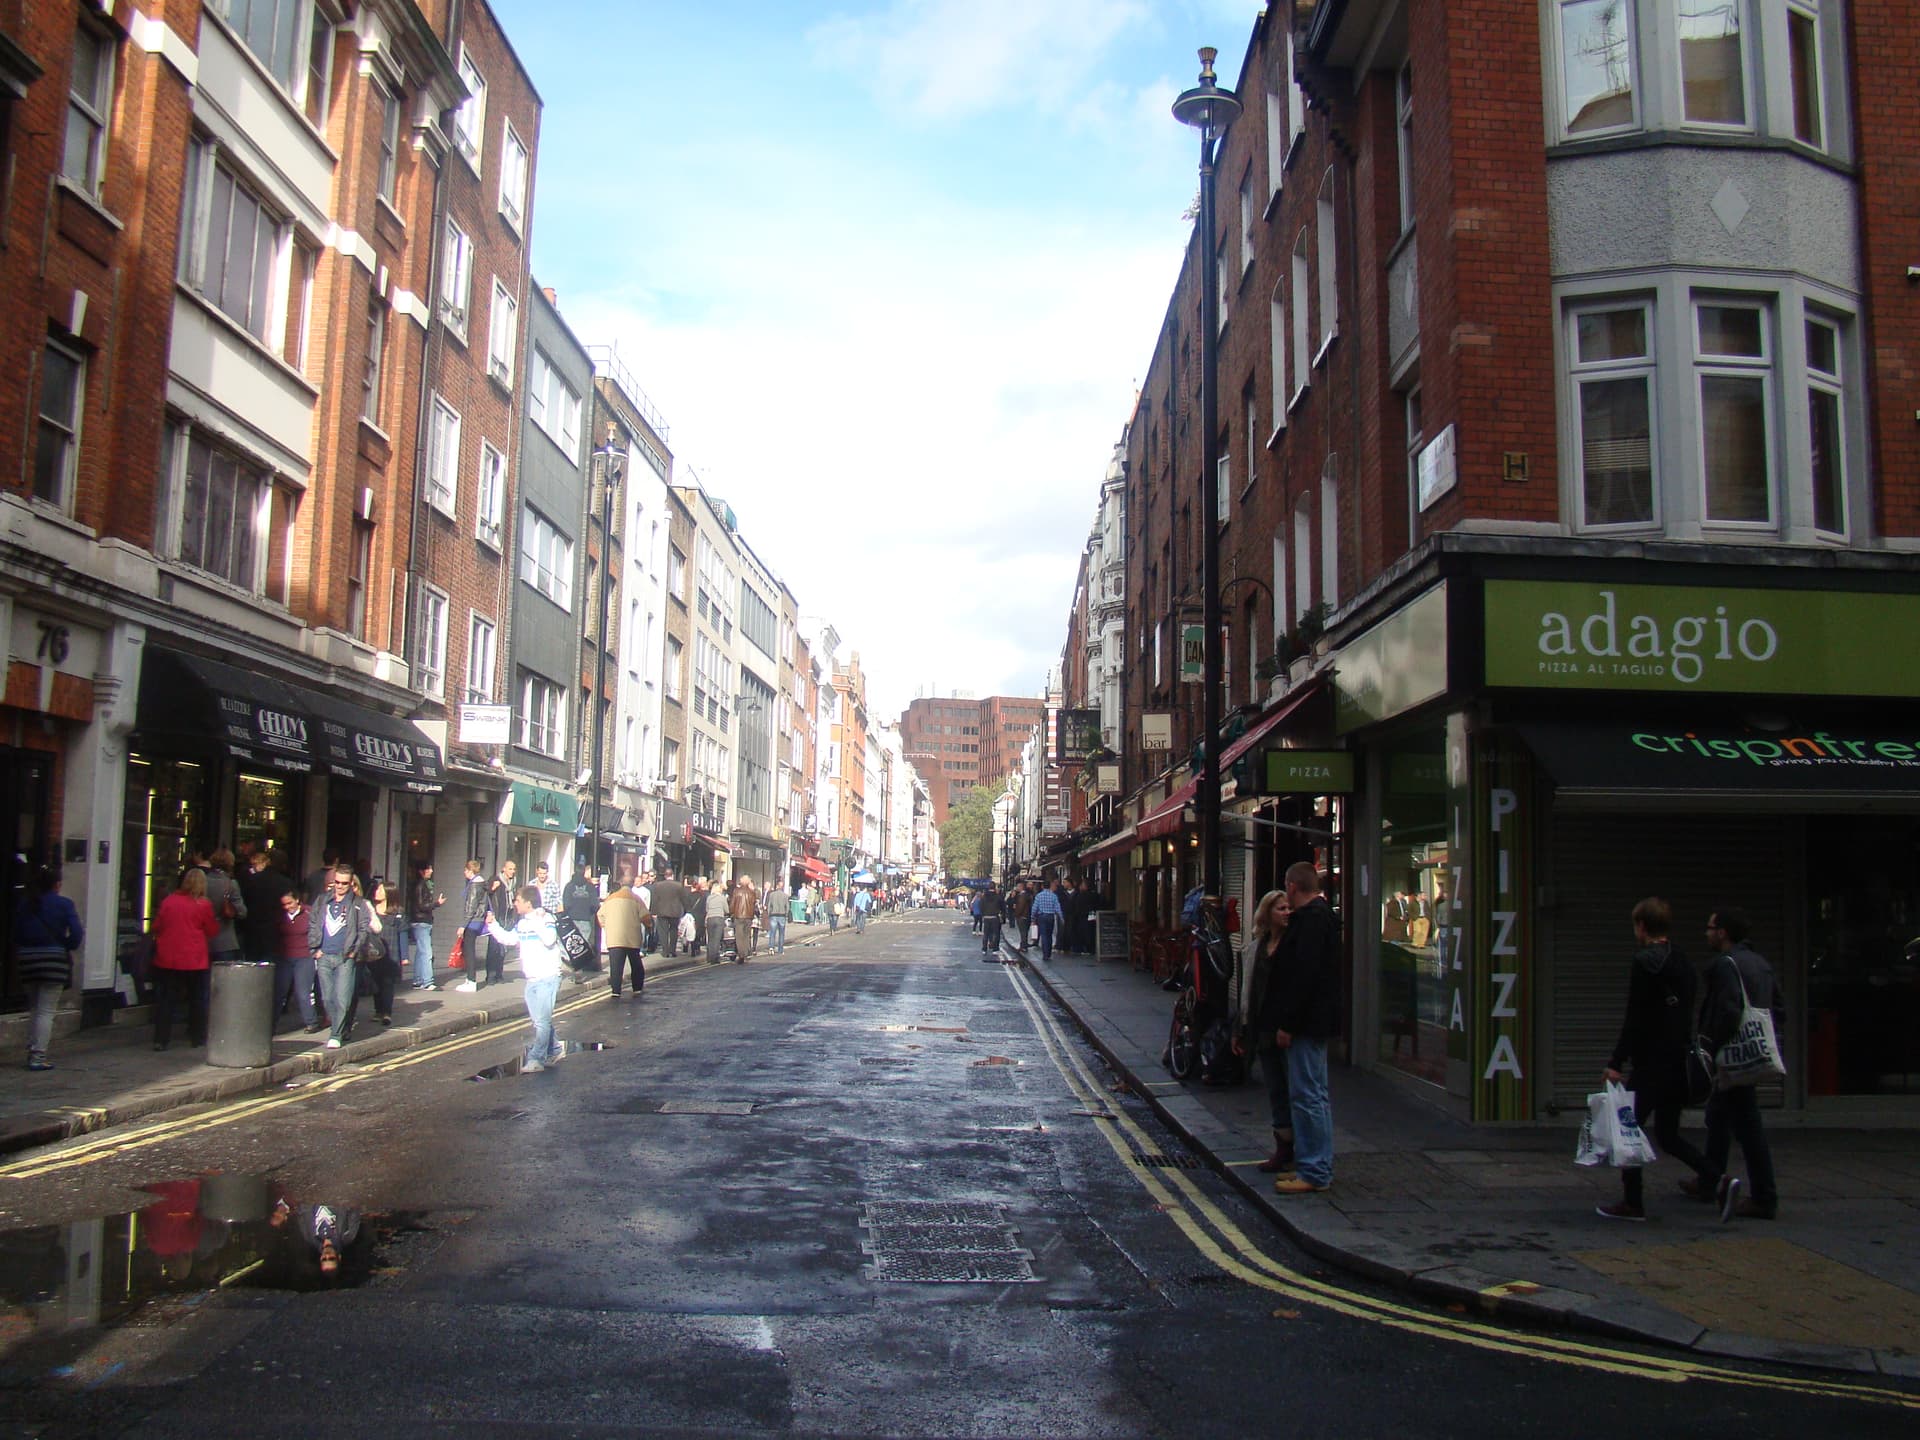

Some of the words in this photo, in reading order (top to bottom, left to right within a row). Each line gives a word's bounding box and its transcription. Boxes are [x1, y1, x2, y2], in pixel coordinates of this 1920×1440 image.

[38, 620, 69, 664] 76
[1538, 591, 1778, 683] adagio
[1538, 662, 1578, 673] PIZZA
[1587, 664, 1605, 674] AL
[1612, 664, 1665, 676] TAGLIO
[258, 709, 307, 742] GERRY'S
[1144, 733, 1166, 748] bar
[355, 733, 414, 764] GERRY'S
[1289, 767, 1330, 778] PIZZA
[1450, 747, 1464, 1032] PIZZA
[1484, 788, 1523, 1080] PIZZA
[1724, 1040, 1770, 1064] TRADE
